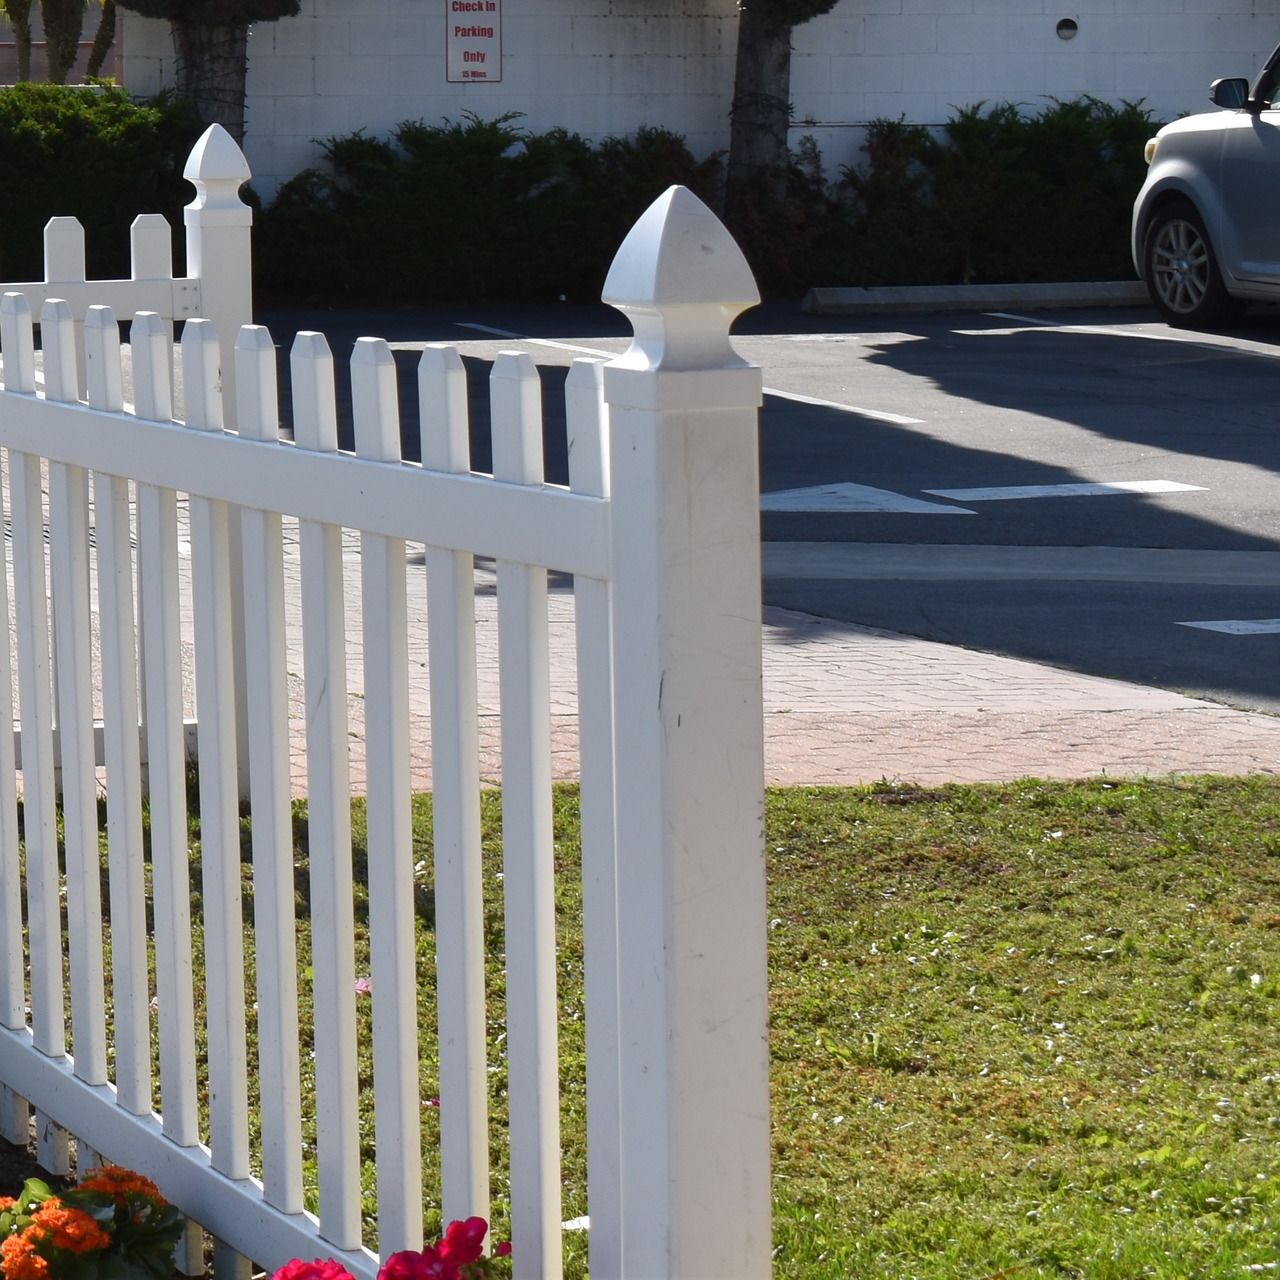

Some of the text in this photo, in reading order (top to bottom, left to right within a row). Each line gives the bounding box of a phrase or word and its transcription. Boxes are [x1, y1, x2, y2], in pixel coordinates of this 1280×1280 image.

[452, 1, 496, 11] Check In
[455, 26, 493, 38] Parking
[464, 51, 485, 63] Only
